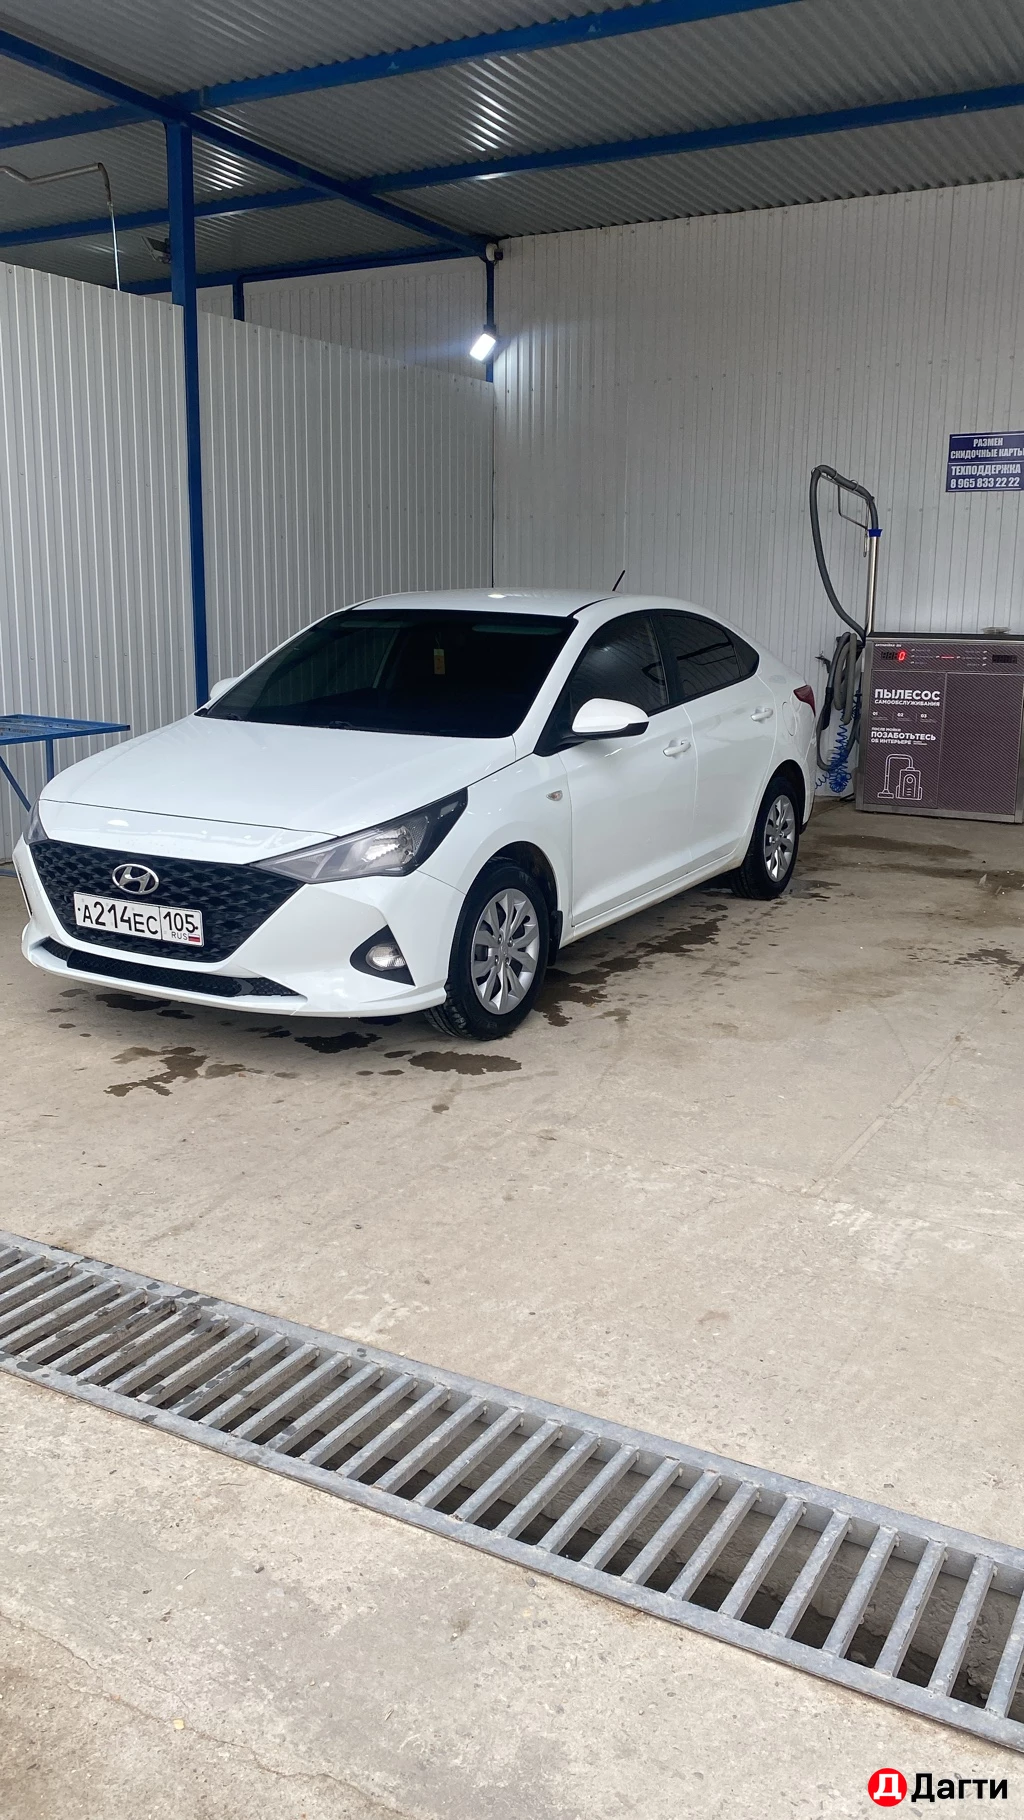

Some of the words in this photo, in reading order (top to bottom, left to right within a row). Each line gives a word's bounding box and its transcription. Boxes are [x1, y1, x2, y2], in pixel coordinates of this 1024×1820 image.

[973, 438, 1003, 447] РАЗМЕН
[950, 449, 997, 459] СКИДОЧНЫЕ
[951, 464, 1021, 476] ТЕХПОДДЕРЖКА
[950, 479, 956, 488] 8
[957, 478, 975, 488] 965
[976, 478, 994, 488] 833
[995, 477, 1007, 487] 22
[1008, 476, 1020, 487] 22
[874, 688, 941, 700] ПЫЛЕСОС
[874, 699, 940, 707] САМООБСЛУЖИВАНИЯ
[871, 731, 936, 741] ПОЗАБОТЬТЕСЬ
[163, 911, 196, 933] 105
[171, 931, 188, 941] RUS
